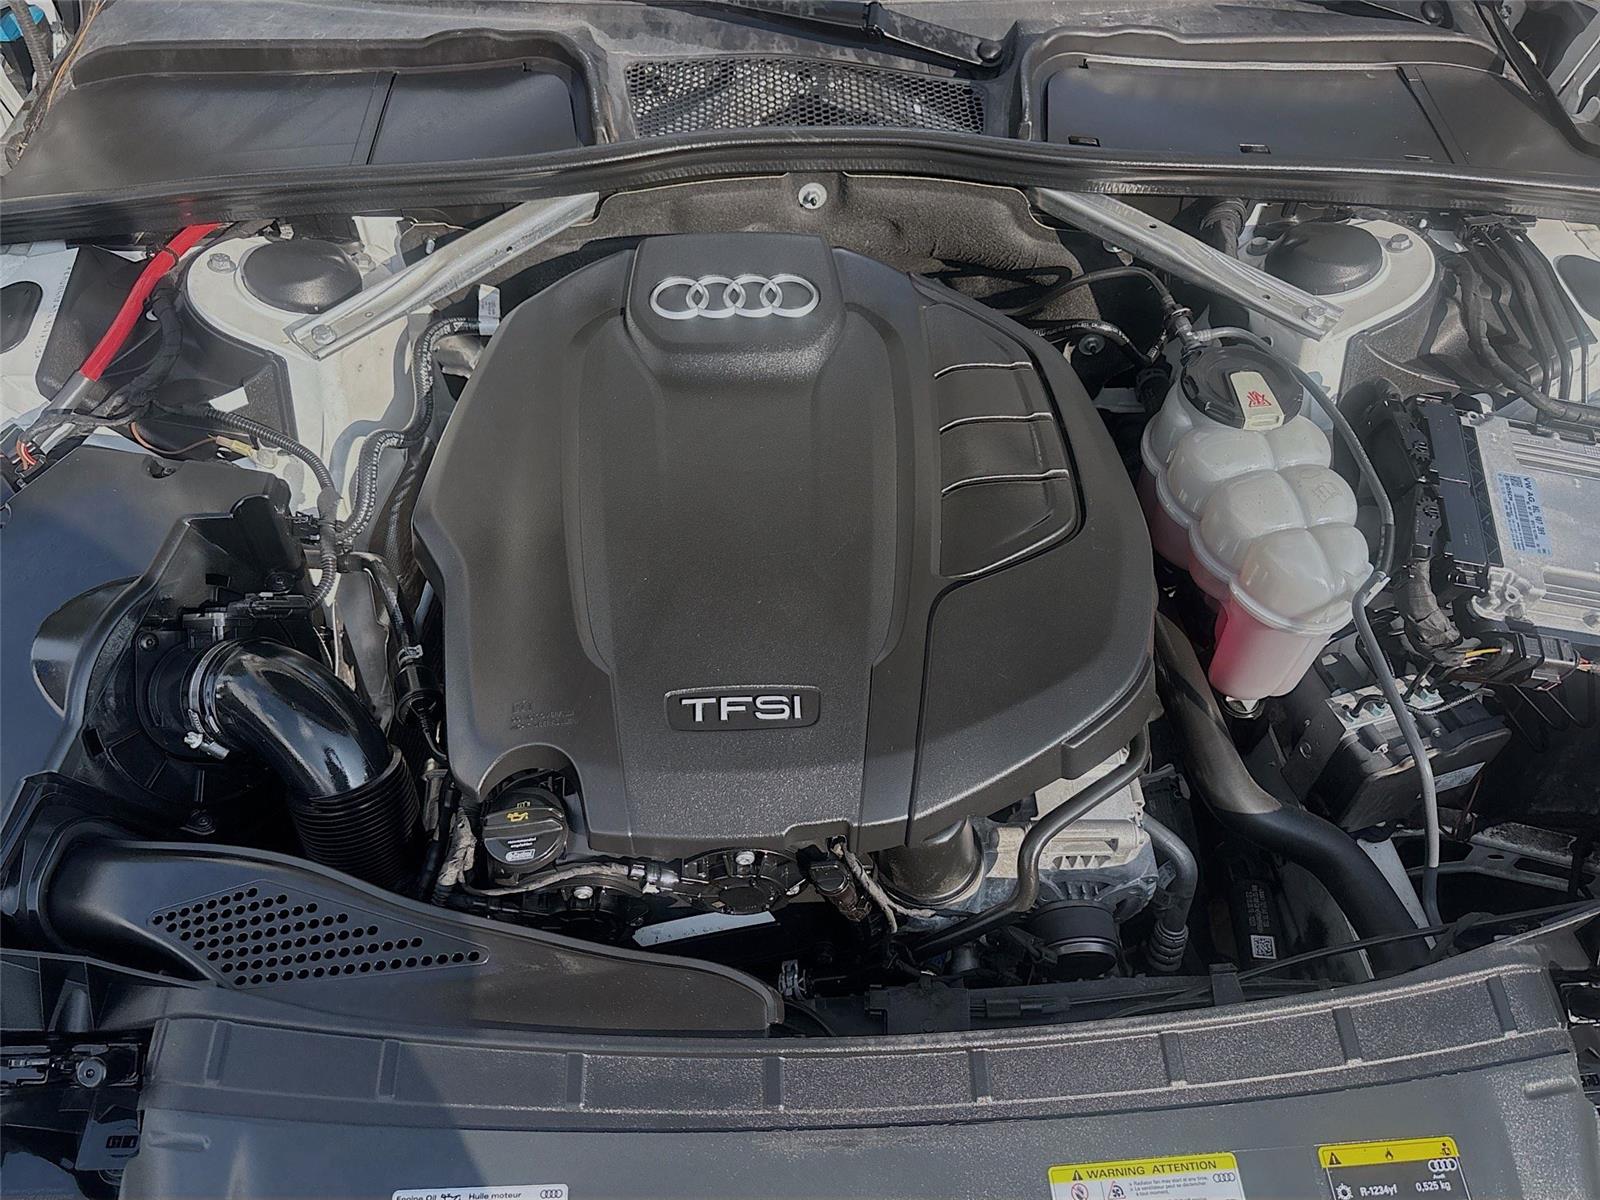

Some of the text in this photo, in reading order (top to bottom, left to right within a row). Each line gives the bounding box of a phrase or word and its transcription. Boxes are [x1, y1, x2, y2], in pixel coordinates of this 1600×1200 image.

[1523, 477, 1533, 492] VW
[1527, 491, 1536, 503] AG
[681, 695, 801, 722] TFSI
[1086, 1160, 1217, 1179] WARNING ATTENTION
[1360, 1183, 1398, 1198] R-1234yf
[1415, 1180, 1452, 1192] 0,525 kg
[468, 1192, 489, 1200] Huile
